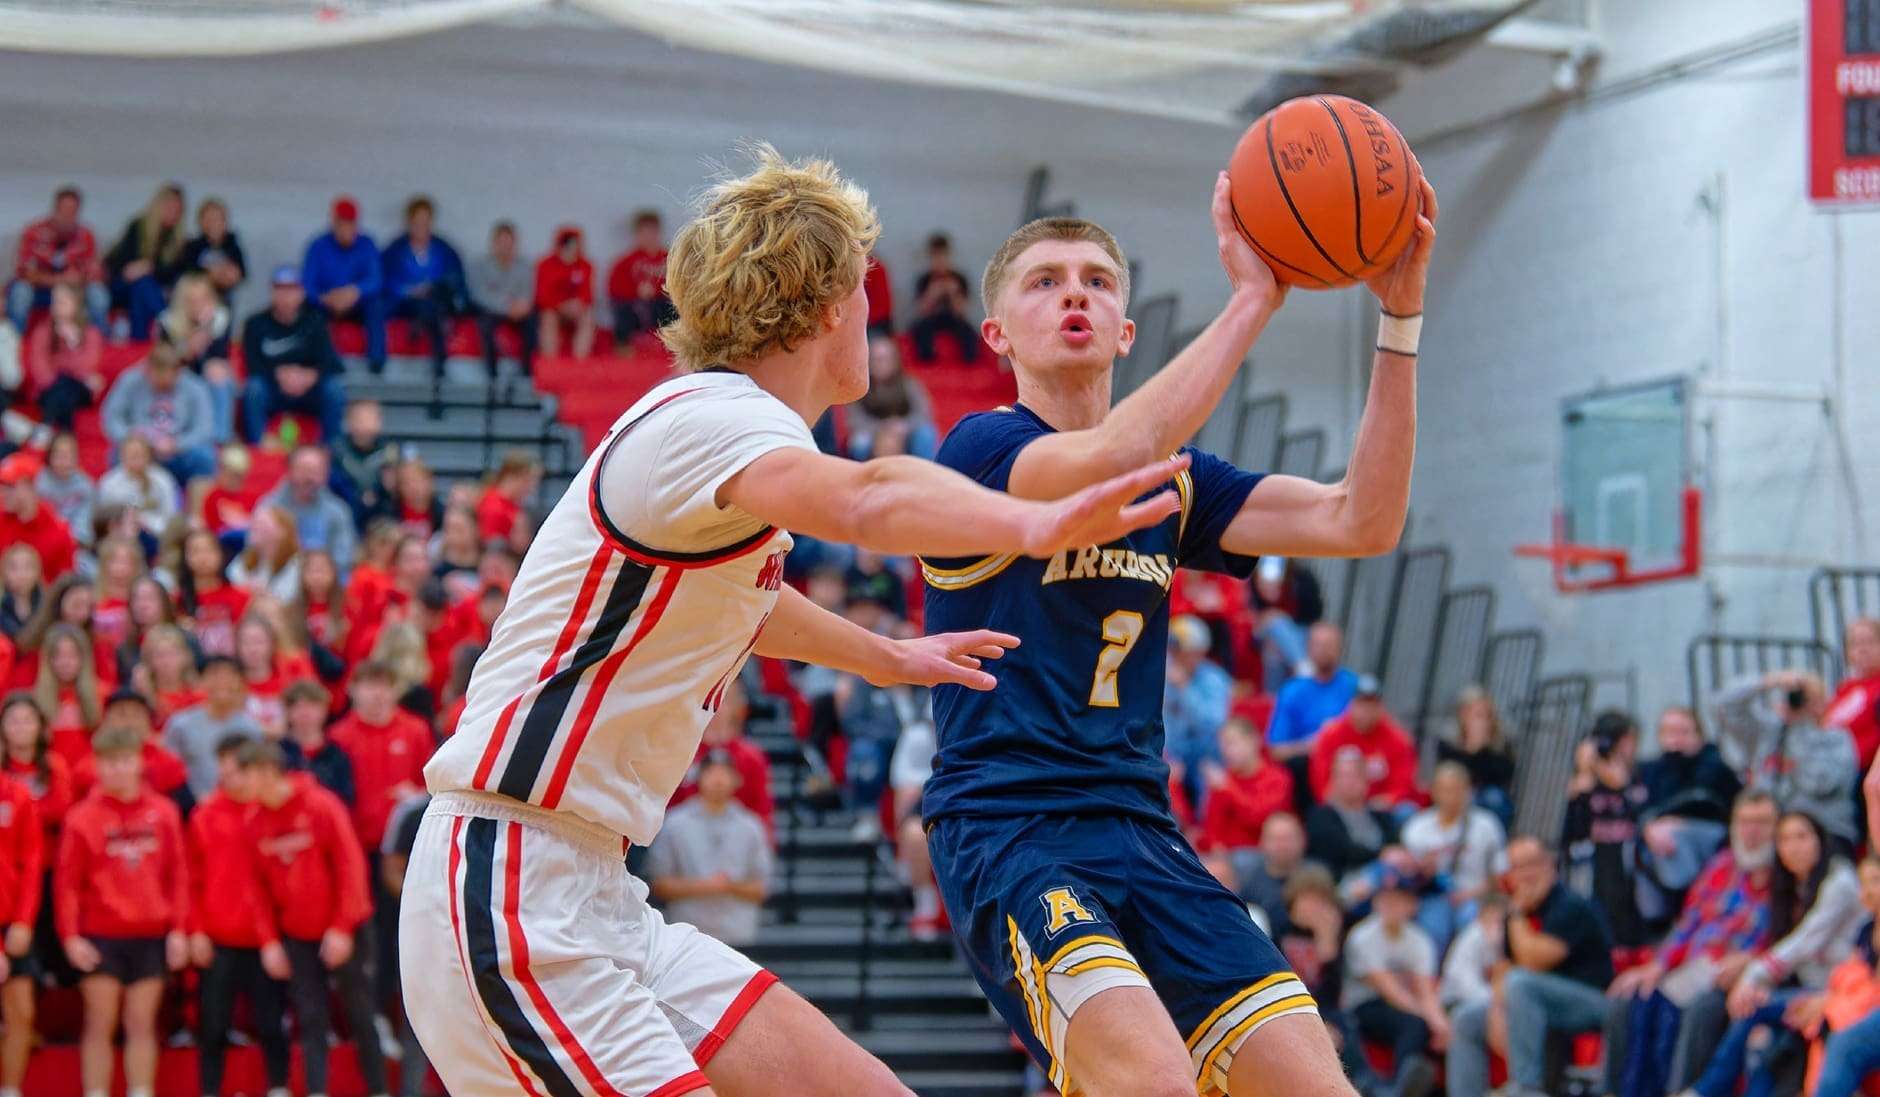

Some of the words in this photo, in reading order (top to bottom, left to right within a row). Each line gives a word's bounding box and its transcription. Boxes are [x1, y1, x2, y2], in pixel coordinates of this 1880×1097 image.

[1349, 102, 1394, 195] OHSAA
[1088, 609, 1144, 708] 2
[1039, 886, 1101, 940] A
